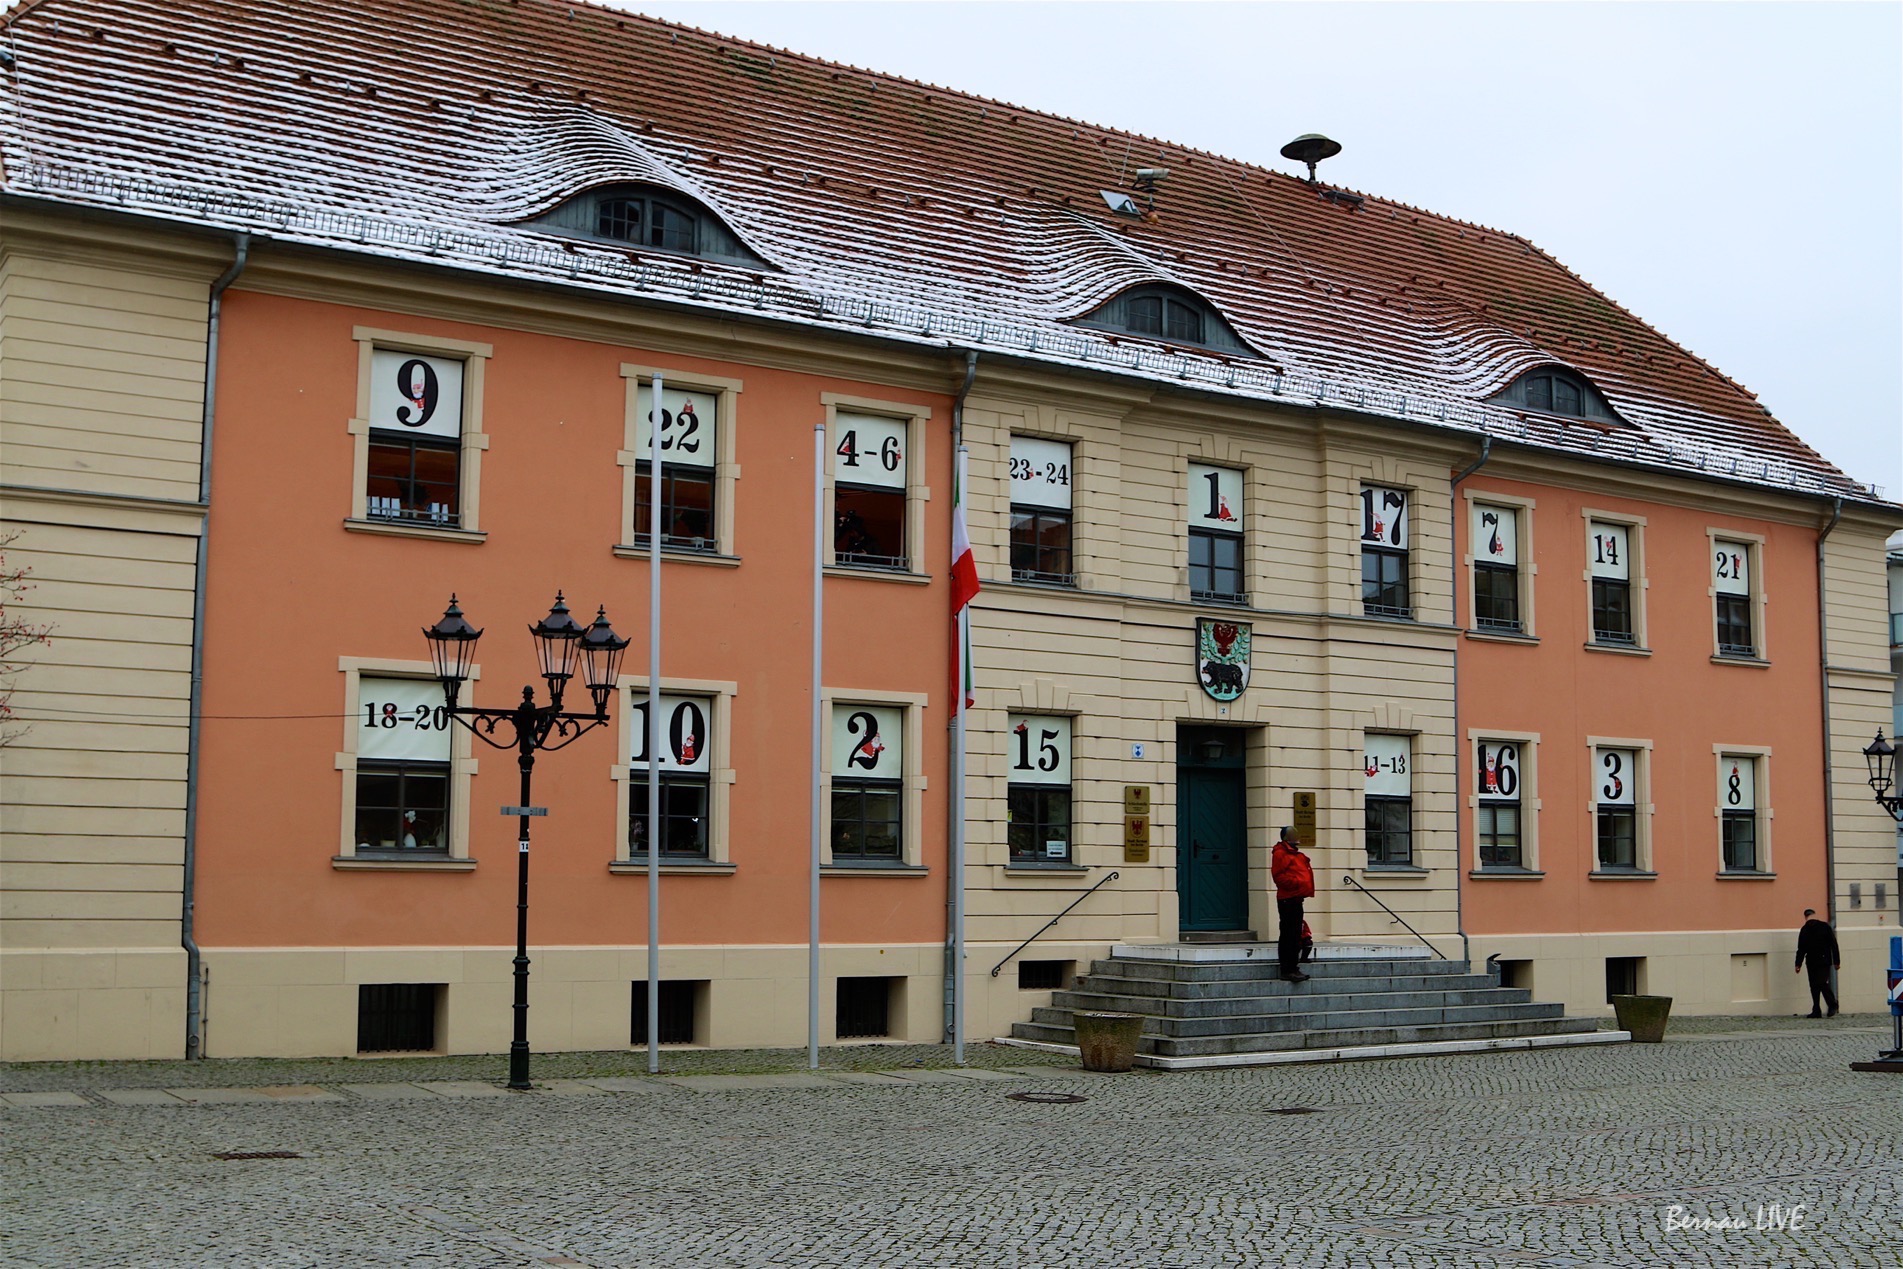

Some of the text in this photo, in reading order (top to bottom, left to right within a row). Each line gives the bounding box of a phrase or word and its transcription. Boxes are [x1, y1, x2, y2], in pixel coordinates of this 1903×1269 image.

[397, 359, 440, 427] 9
[648, 409, 699, 454] 22
[837, 430, 900, 472] 4-6
[1204, 472, 1223, 519] 1
[1361, 488, 1405, 547] 17
[1482, 511, 1499, 554] 7
[1595, 535, 1618, 565] 14
[1715, 552, 1739, 579] 21
[365, 702, 447, 731] 18-20
[631, 699, 706, 765] 10
[848, 711, 880, 770] 2
[1013, 729, 1060, 772] 15
[1364, 754, 1406, 775] 11-13
[1477, 745, 1517, 795] 16
[1604, 752, 1623, 800] 3
[1728, 775, 1741, 805] 8
